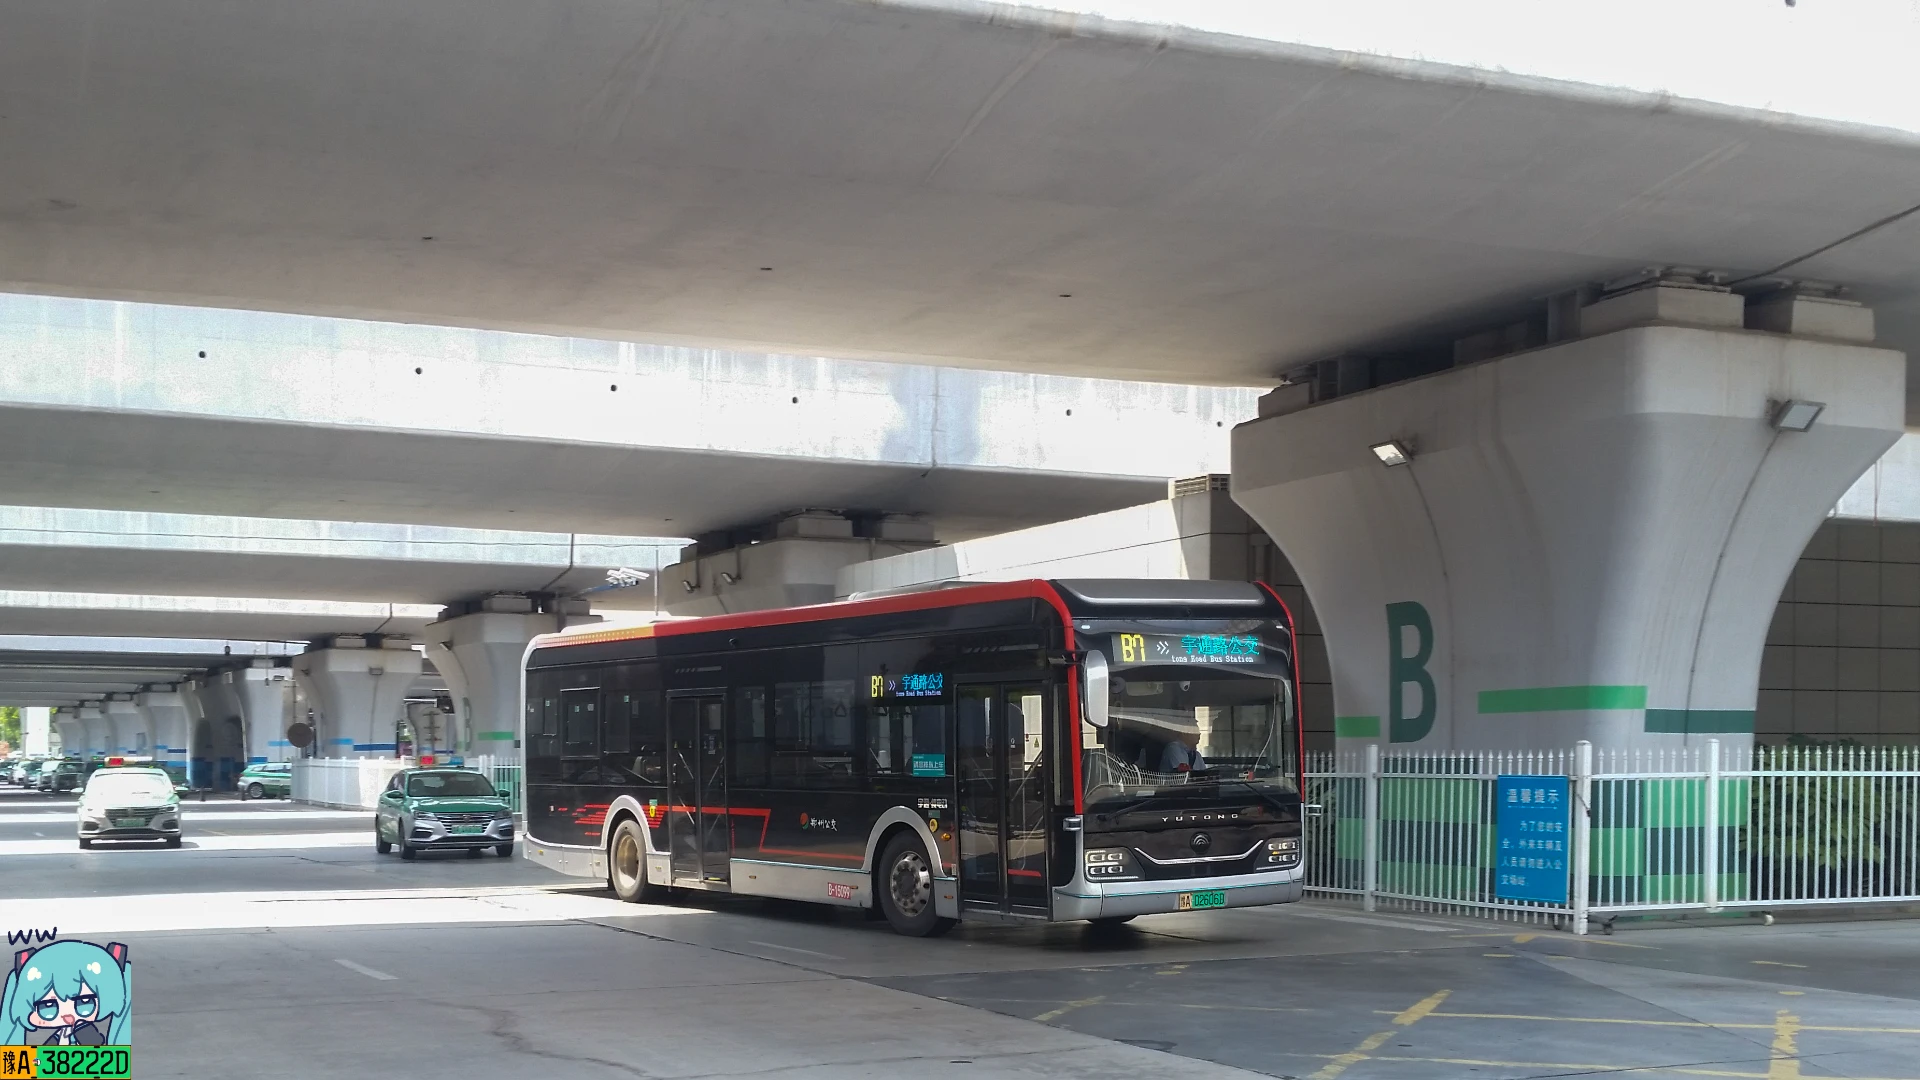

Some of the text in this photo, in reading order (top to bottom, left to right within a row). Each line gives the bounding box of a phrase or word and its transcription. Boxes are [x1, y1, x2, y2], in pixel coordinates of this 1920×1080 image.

[1120, 633, 1146, 662] B7
[1181, 635, 1260, 656] 宇通路公交
[1190, 655, 1207, 663] Road
[1210, 655, 1223, 663] Bus
[1225, 655, 1254, 663] Station
[1385, 601, 1437, 744] B
[871, 675, 884, 697] B7
[1506, 788, 1560, 804] 温馨提示
[810, 817, 838, 832] 郑州公交
[1162, 813, 1239, 823] YUTONG
[828, 883, 851, 899] B-15099
